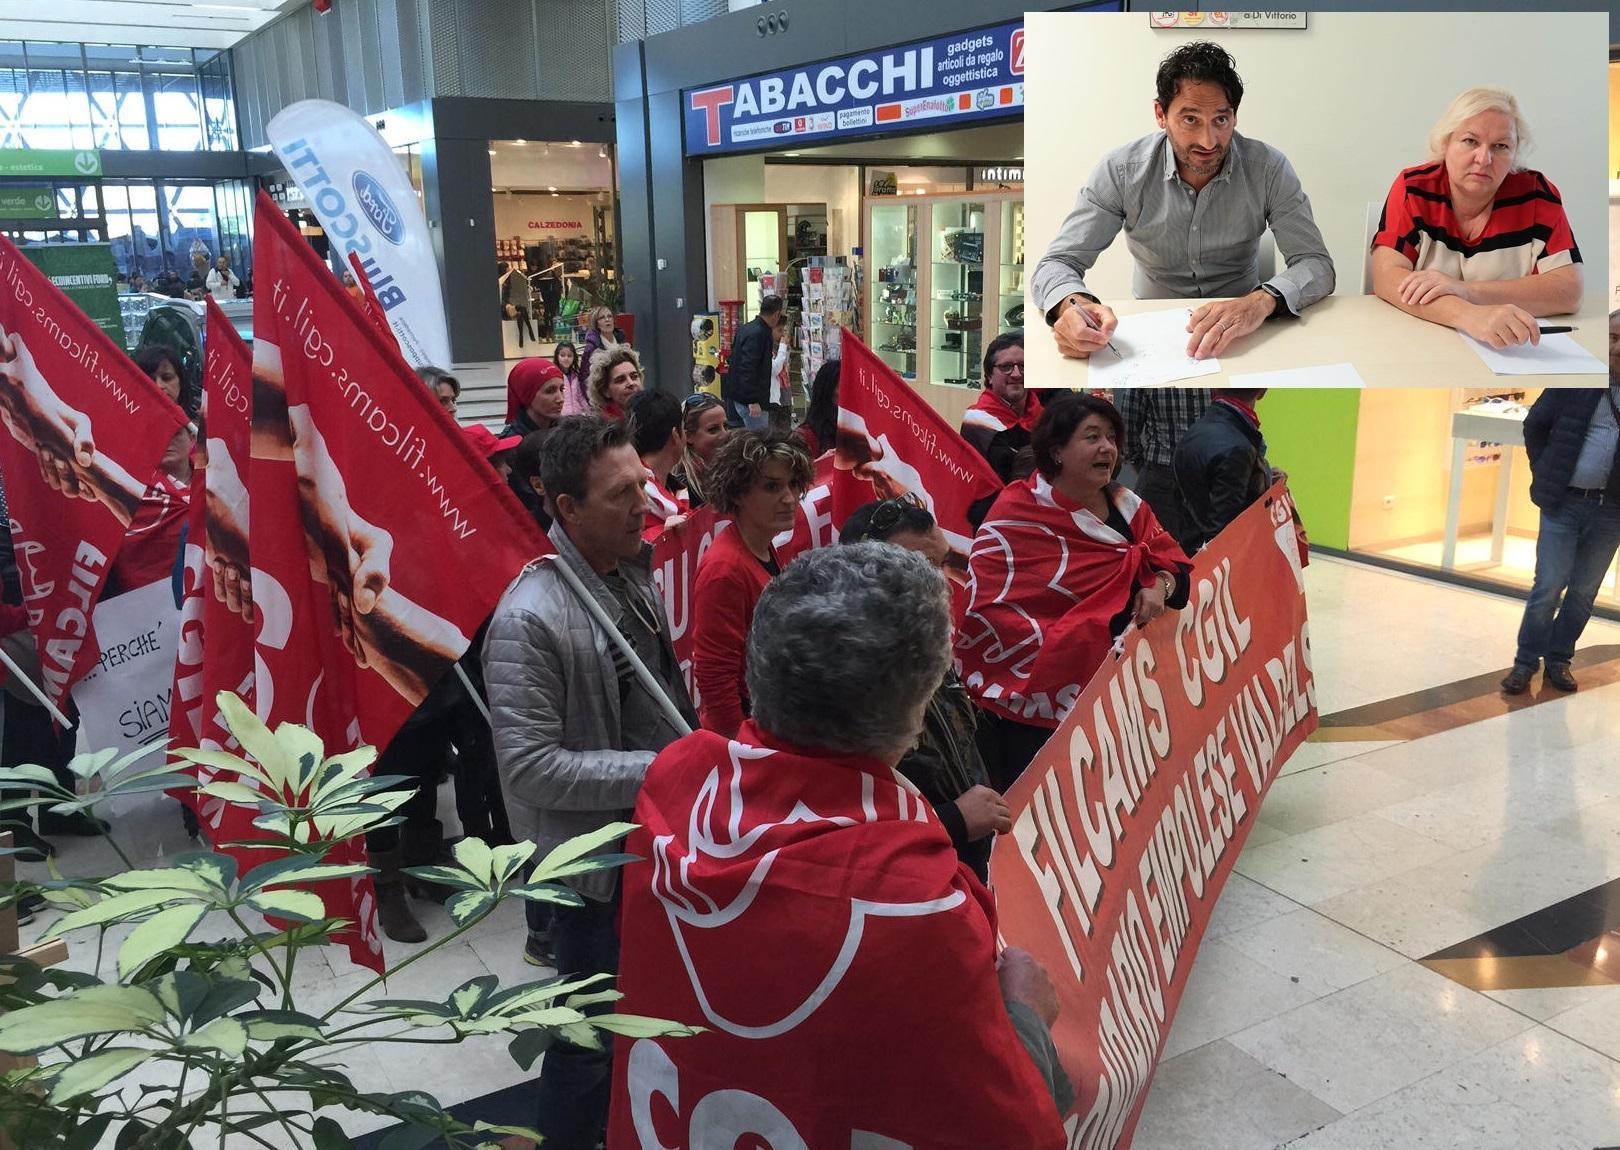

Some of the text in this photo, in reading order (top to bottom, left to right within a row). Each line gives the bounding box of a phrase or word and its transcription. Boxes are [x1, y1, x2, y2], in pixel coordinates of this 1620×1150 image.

[1265, 12, 1297, 20] Vittorio
[948, 35, 994, 56] gadgets
[938, 48, 1004, 72] articoli da regalo
[942, 66, 998, 87] oggettistica
[691, 46, 934, 146] TABACCHI
[840, 108, 871, 119] pagamento
[905, 100, 949, 118] SuperEnalotto
[842, 118, 868, 127] bollettini
[527, 221, 583, 230] CALZEDONIA
[1013, 557, 1252, 983] FILCAMS CGIL
[1139, 717, 1248, 985] EMPOLESE
